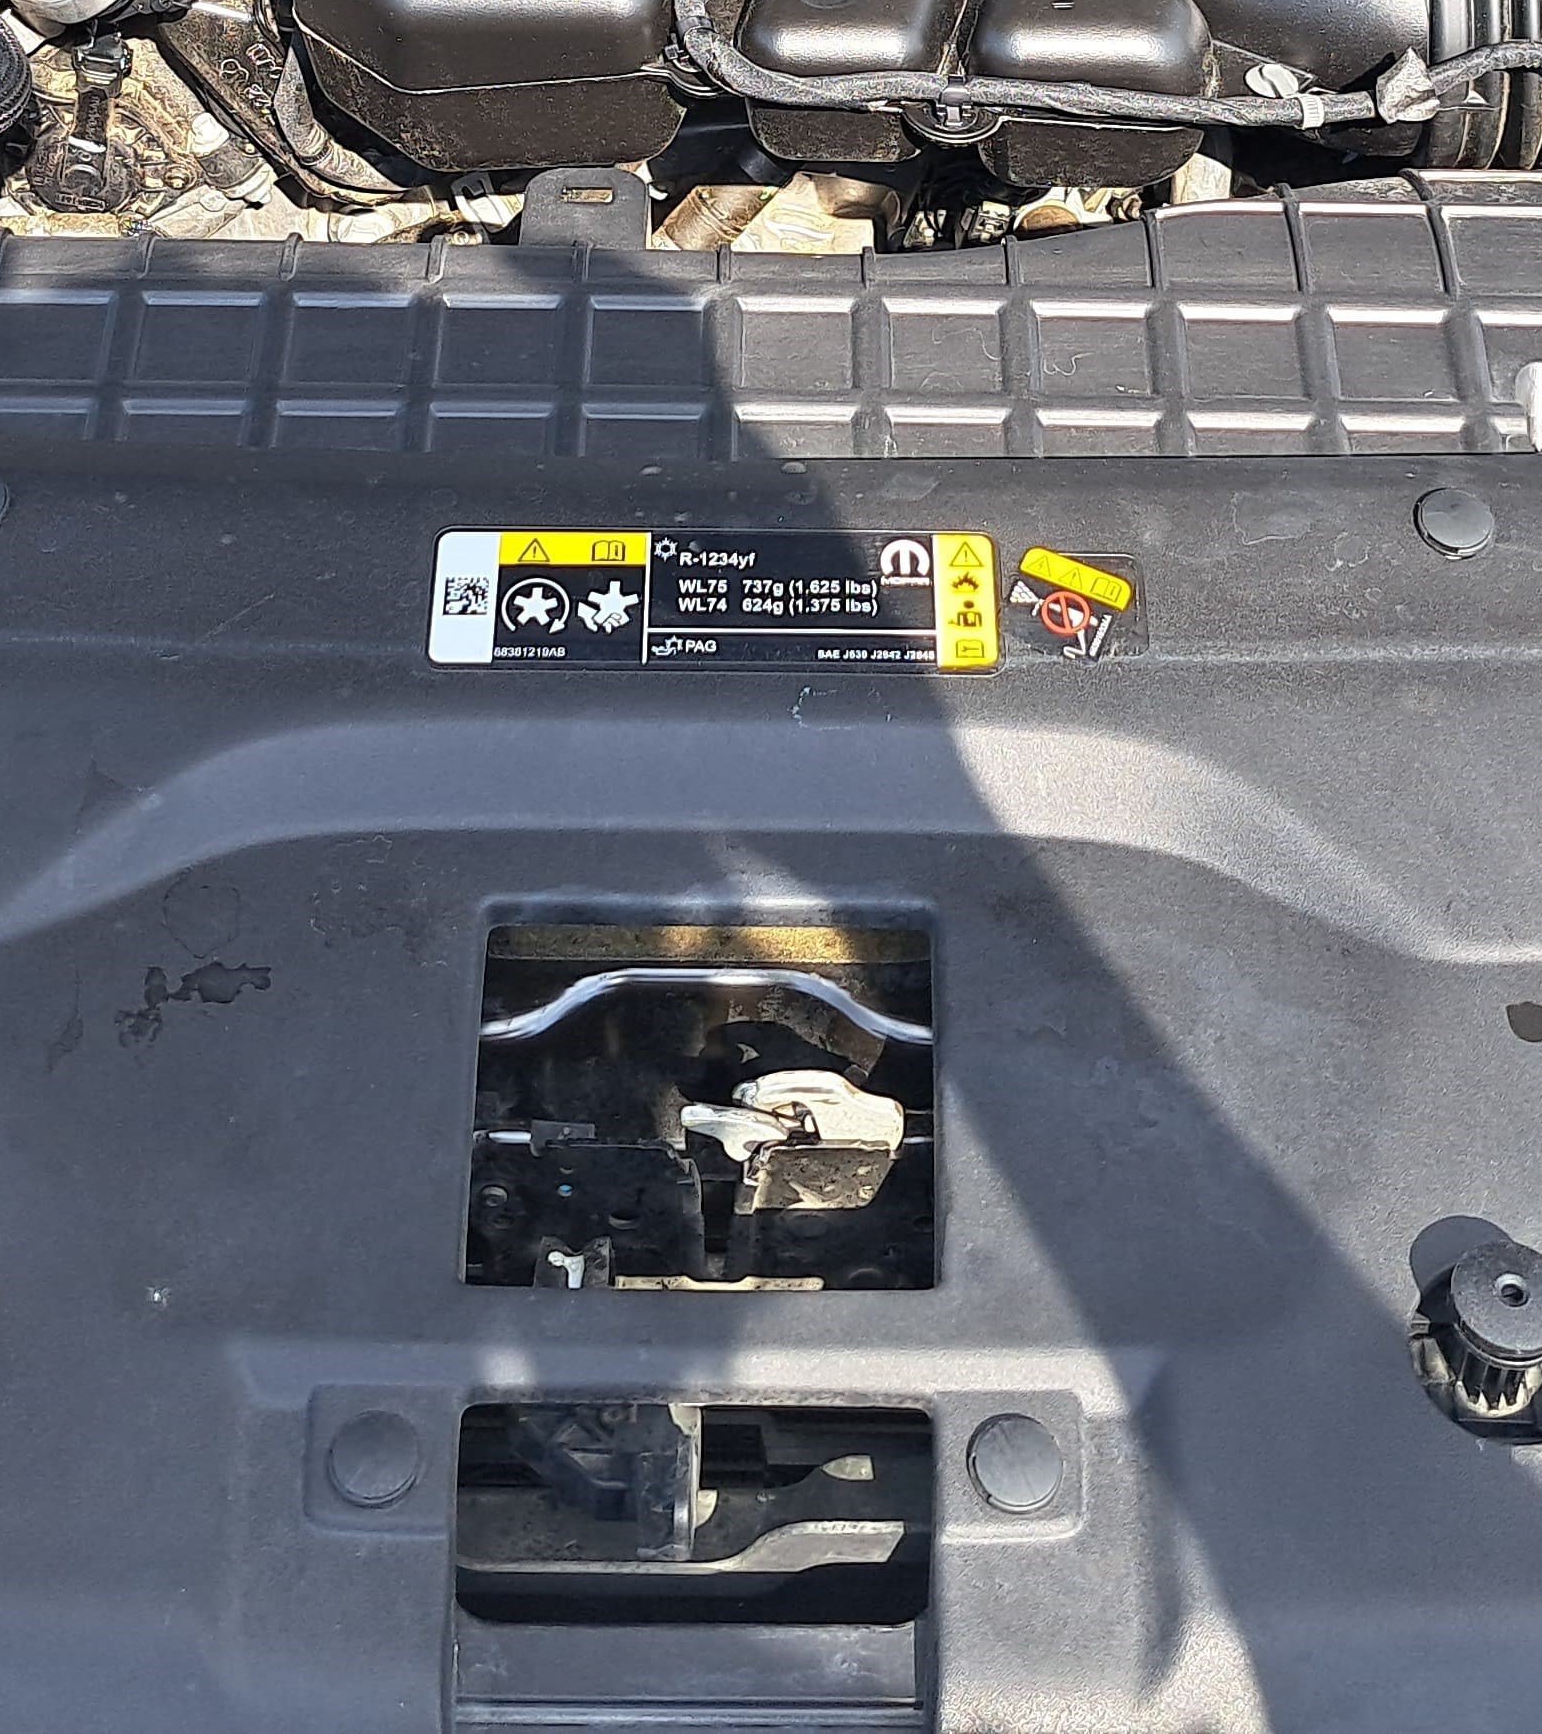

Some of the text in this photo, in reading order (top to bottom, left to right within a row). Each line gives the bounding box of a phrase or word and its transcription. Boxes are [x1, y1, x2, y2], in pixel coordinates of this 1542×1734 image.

[679, 551, 756, 570] R-1234yf
[679, 579, 728, 595] WL75
[742, 579, 784, 598] 737g
[845, 579, 878, 598] lbs)
[679, 597, 728, 613] WL74
[742, 598, 784, 617] 624g
[845, 597, 878, 617] lbs)
[685, 640, 717, 653] PAG
